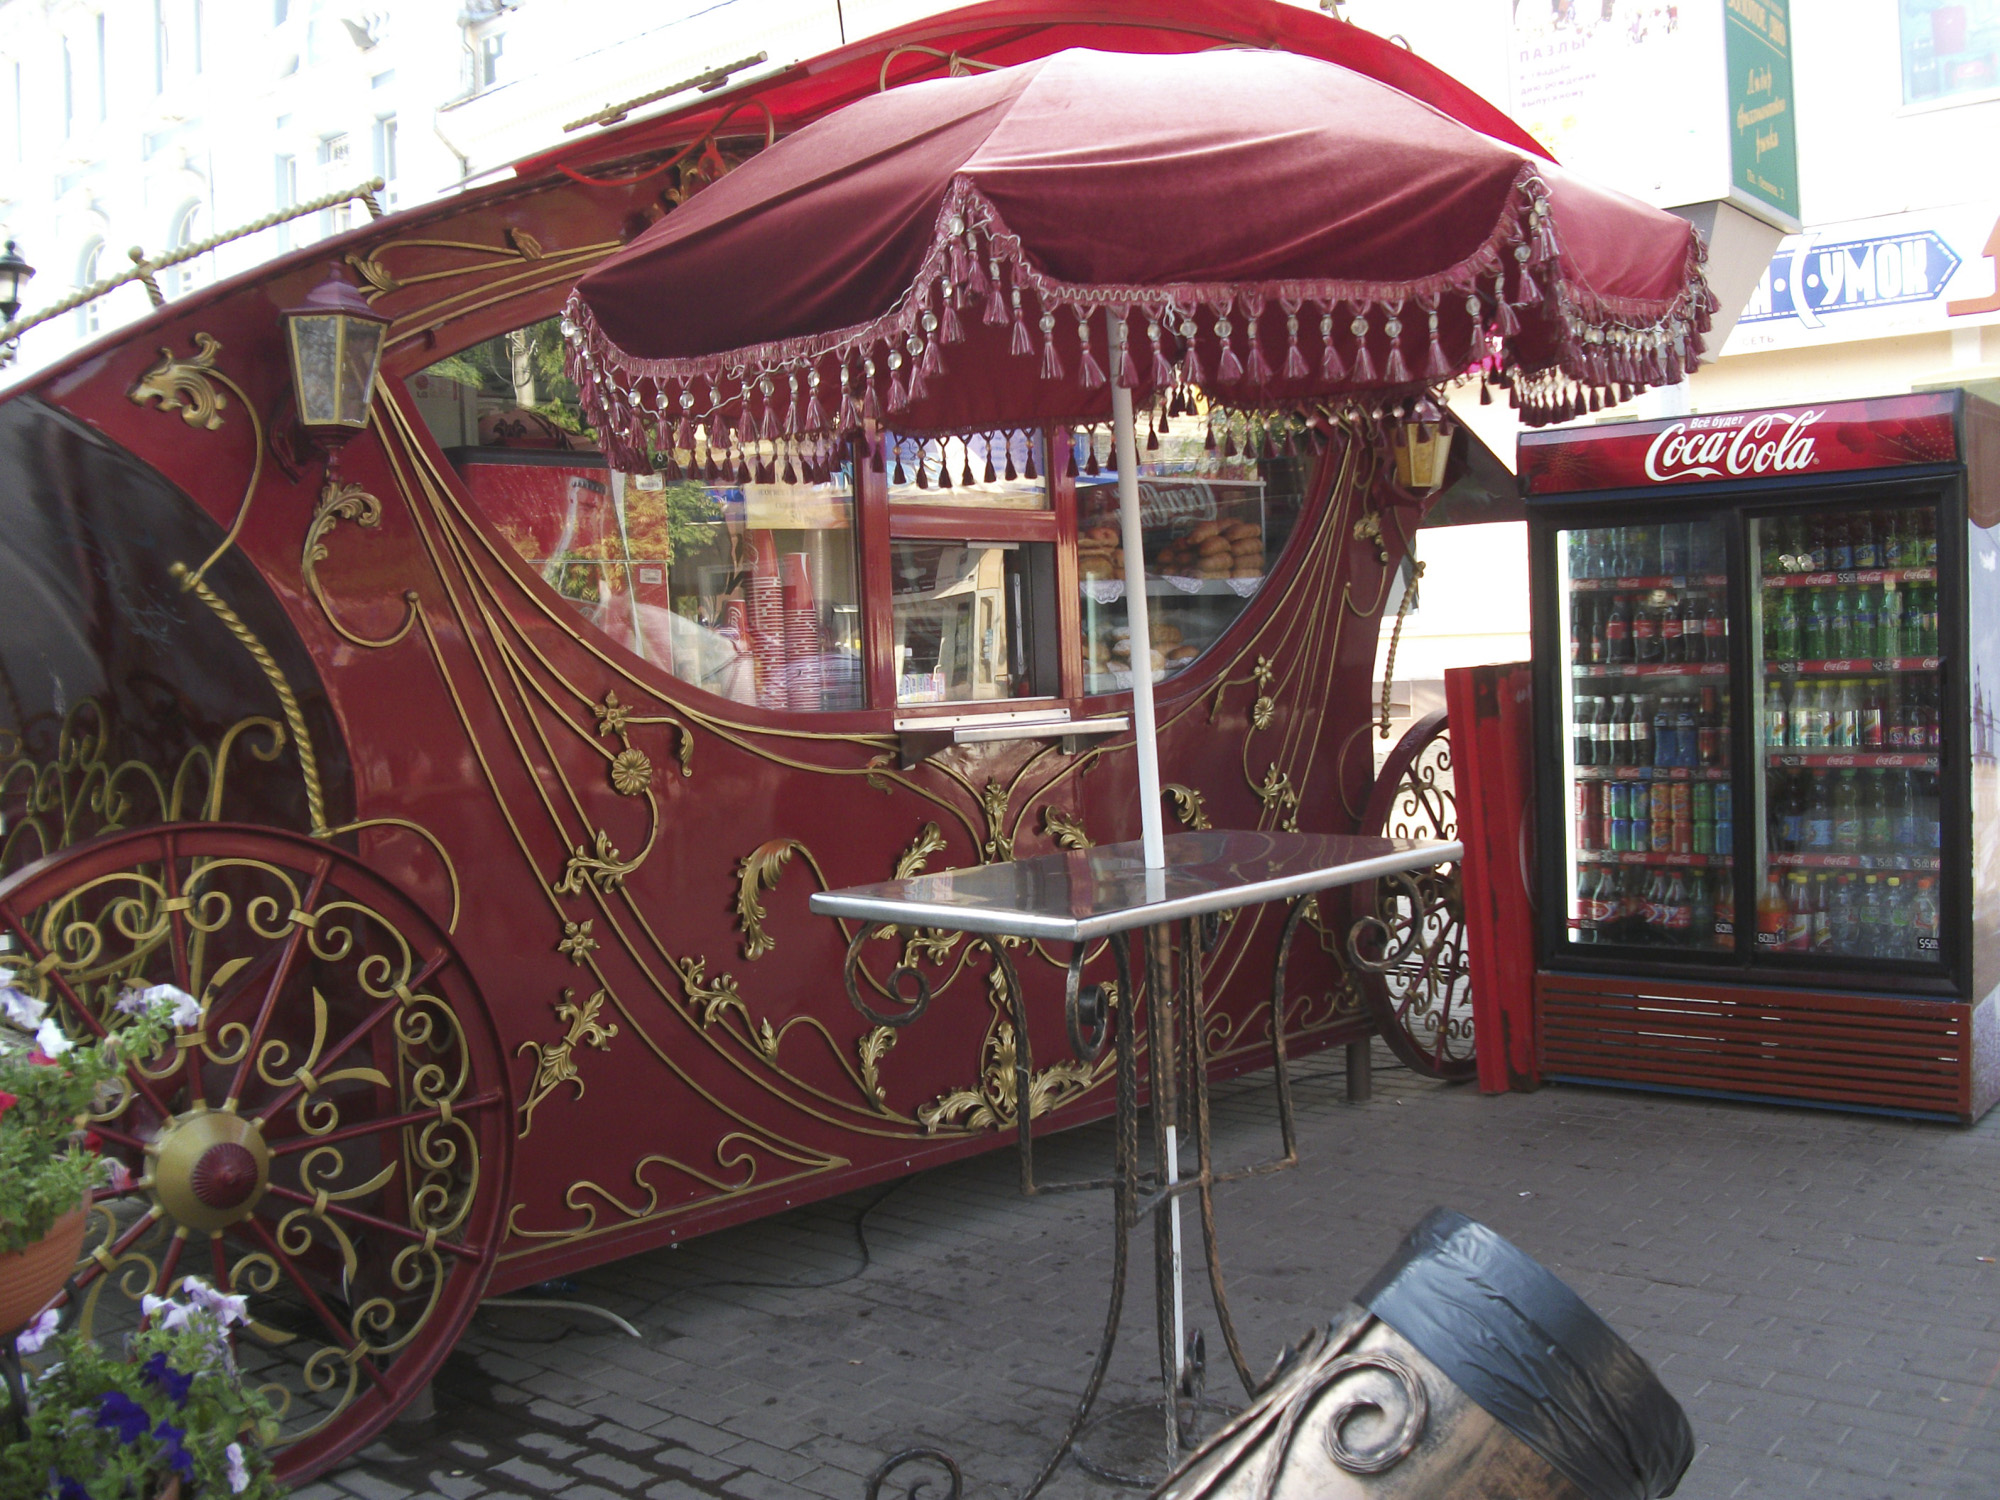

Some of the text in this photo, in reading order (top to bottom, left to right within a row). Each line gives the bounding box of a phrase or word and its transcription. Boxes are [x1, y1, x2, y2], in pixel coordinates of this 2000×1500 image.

[1519, 37, 1586, 63] ПАЗЛЫ
[1689, 414, 1745, 430] Всё будет
[1644, 409, 1827, 482] Coca-Cola
